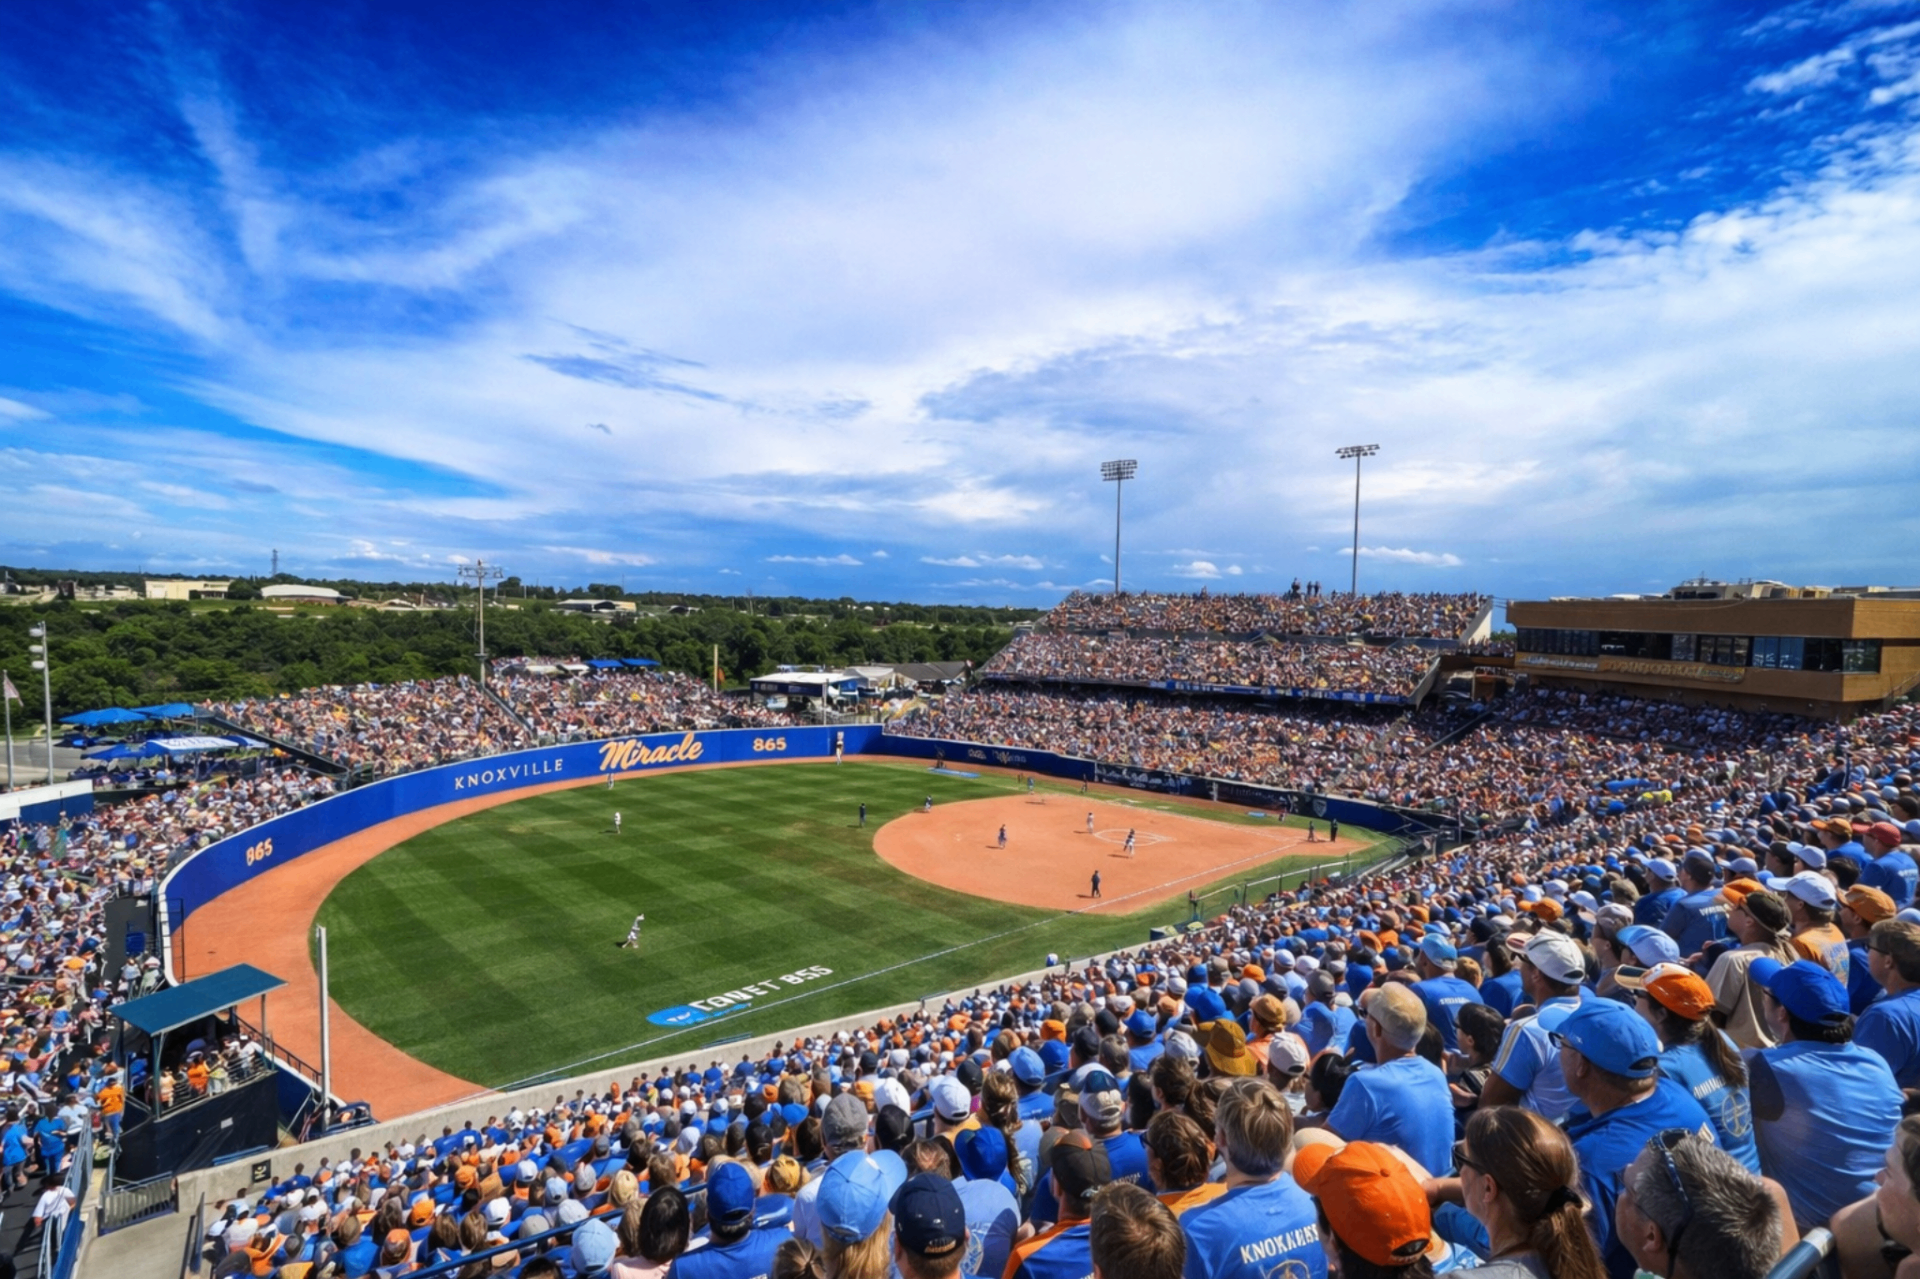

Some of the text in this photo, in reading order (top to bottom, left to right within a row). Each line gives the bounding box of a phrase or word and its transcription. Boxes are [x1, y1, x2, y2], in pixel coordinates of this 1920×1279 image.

[599, 732, 704, 771] Miracle
[753, 737, 787, 751] 865
[454, 758, 563, 790] KNOXVILLE
[246, 837, 273, 866] 865
